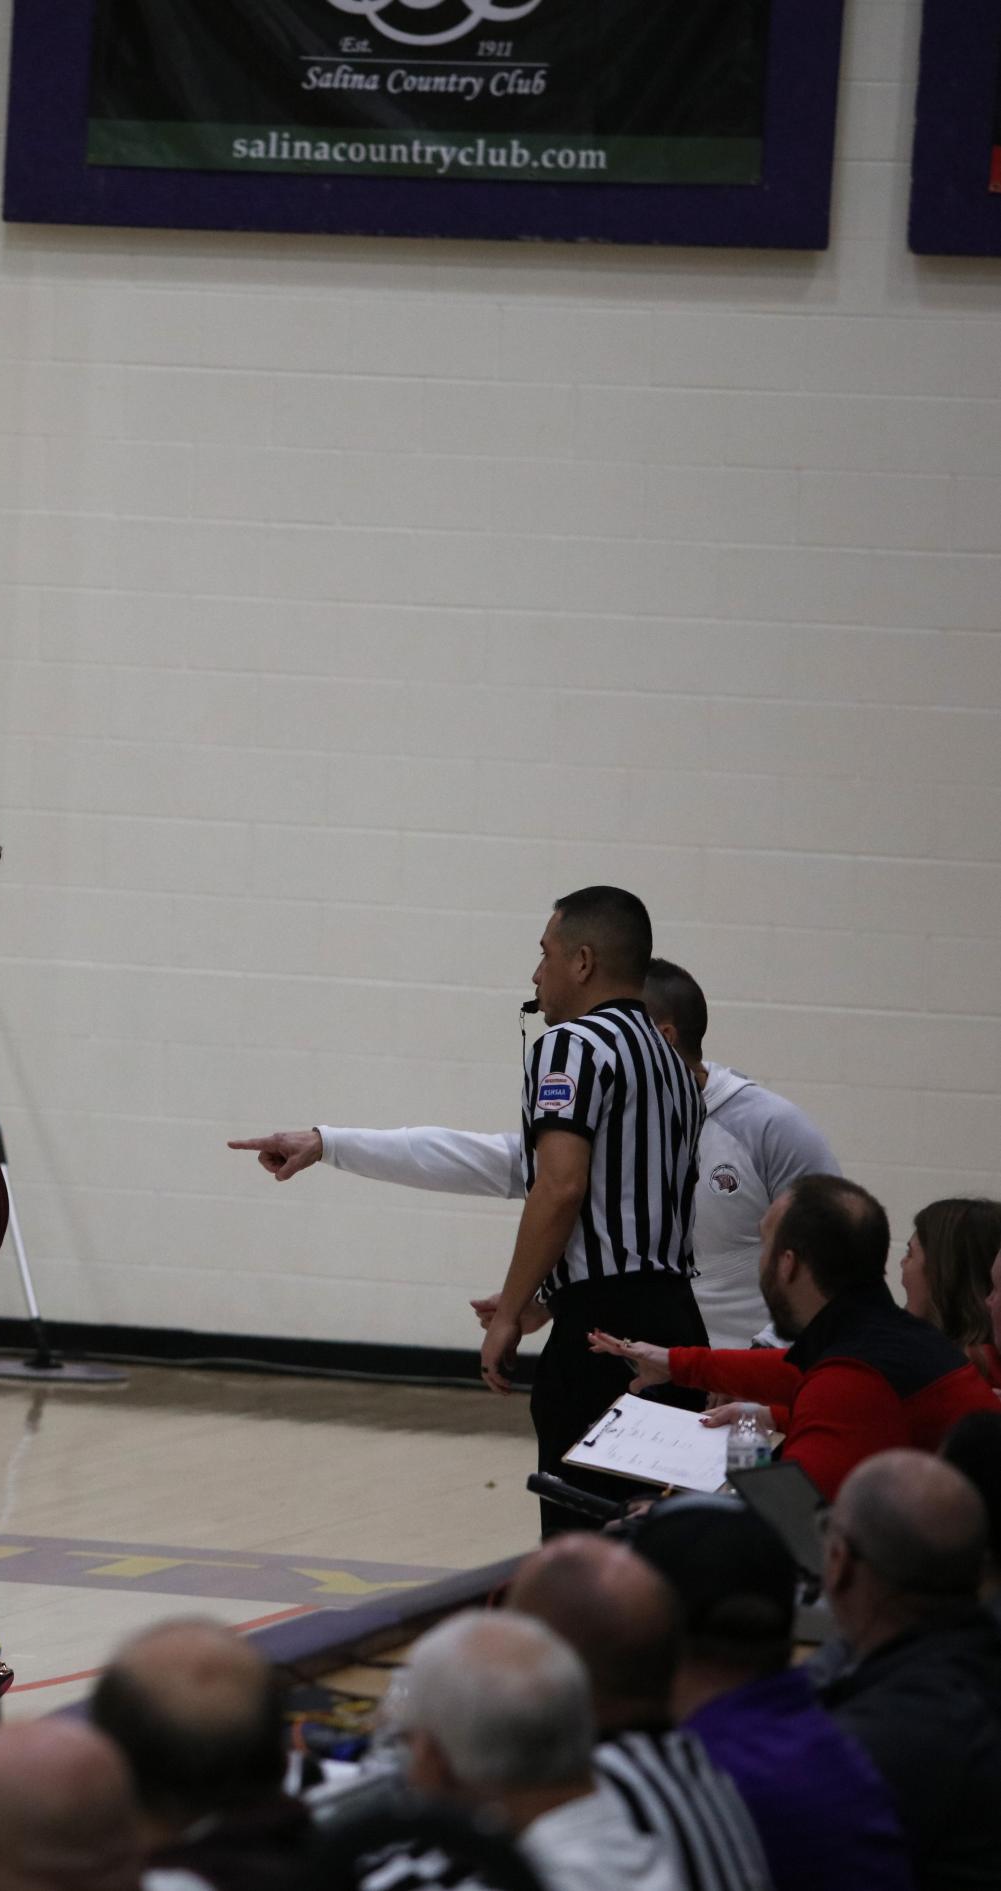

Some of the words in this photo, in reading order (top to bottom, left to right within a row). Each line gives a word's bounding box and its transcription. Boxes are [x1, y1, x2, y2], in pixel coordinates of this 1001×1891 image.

[476, 40, 513, 57] 1911
[301, 64, 380, 90] Salina
[386, 69, 484, 101] Country
[489, 69, 547, 97] Club
[232, 132, 608, 174] salinacountryclub.com
